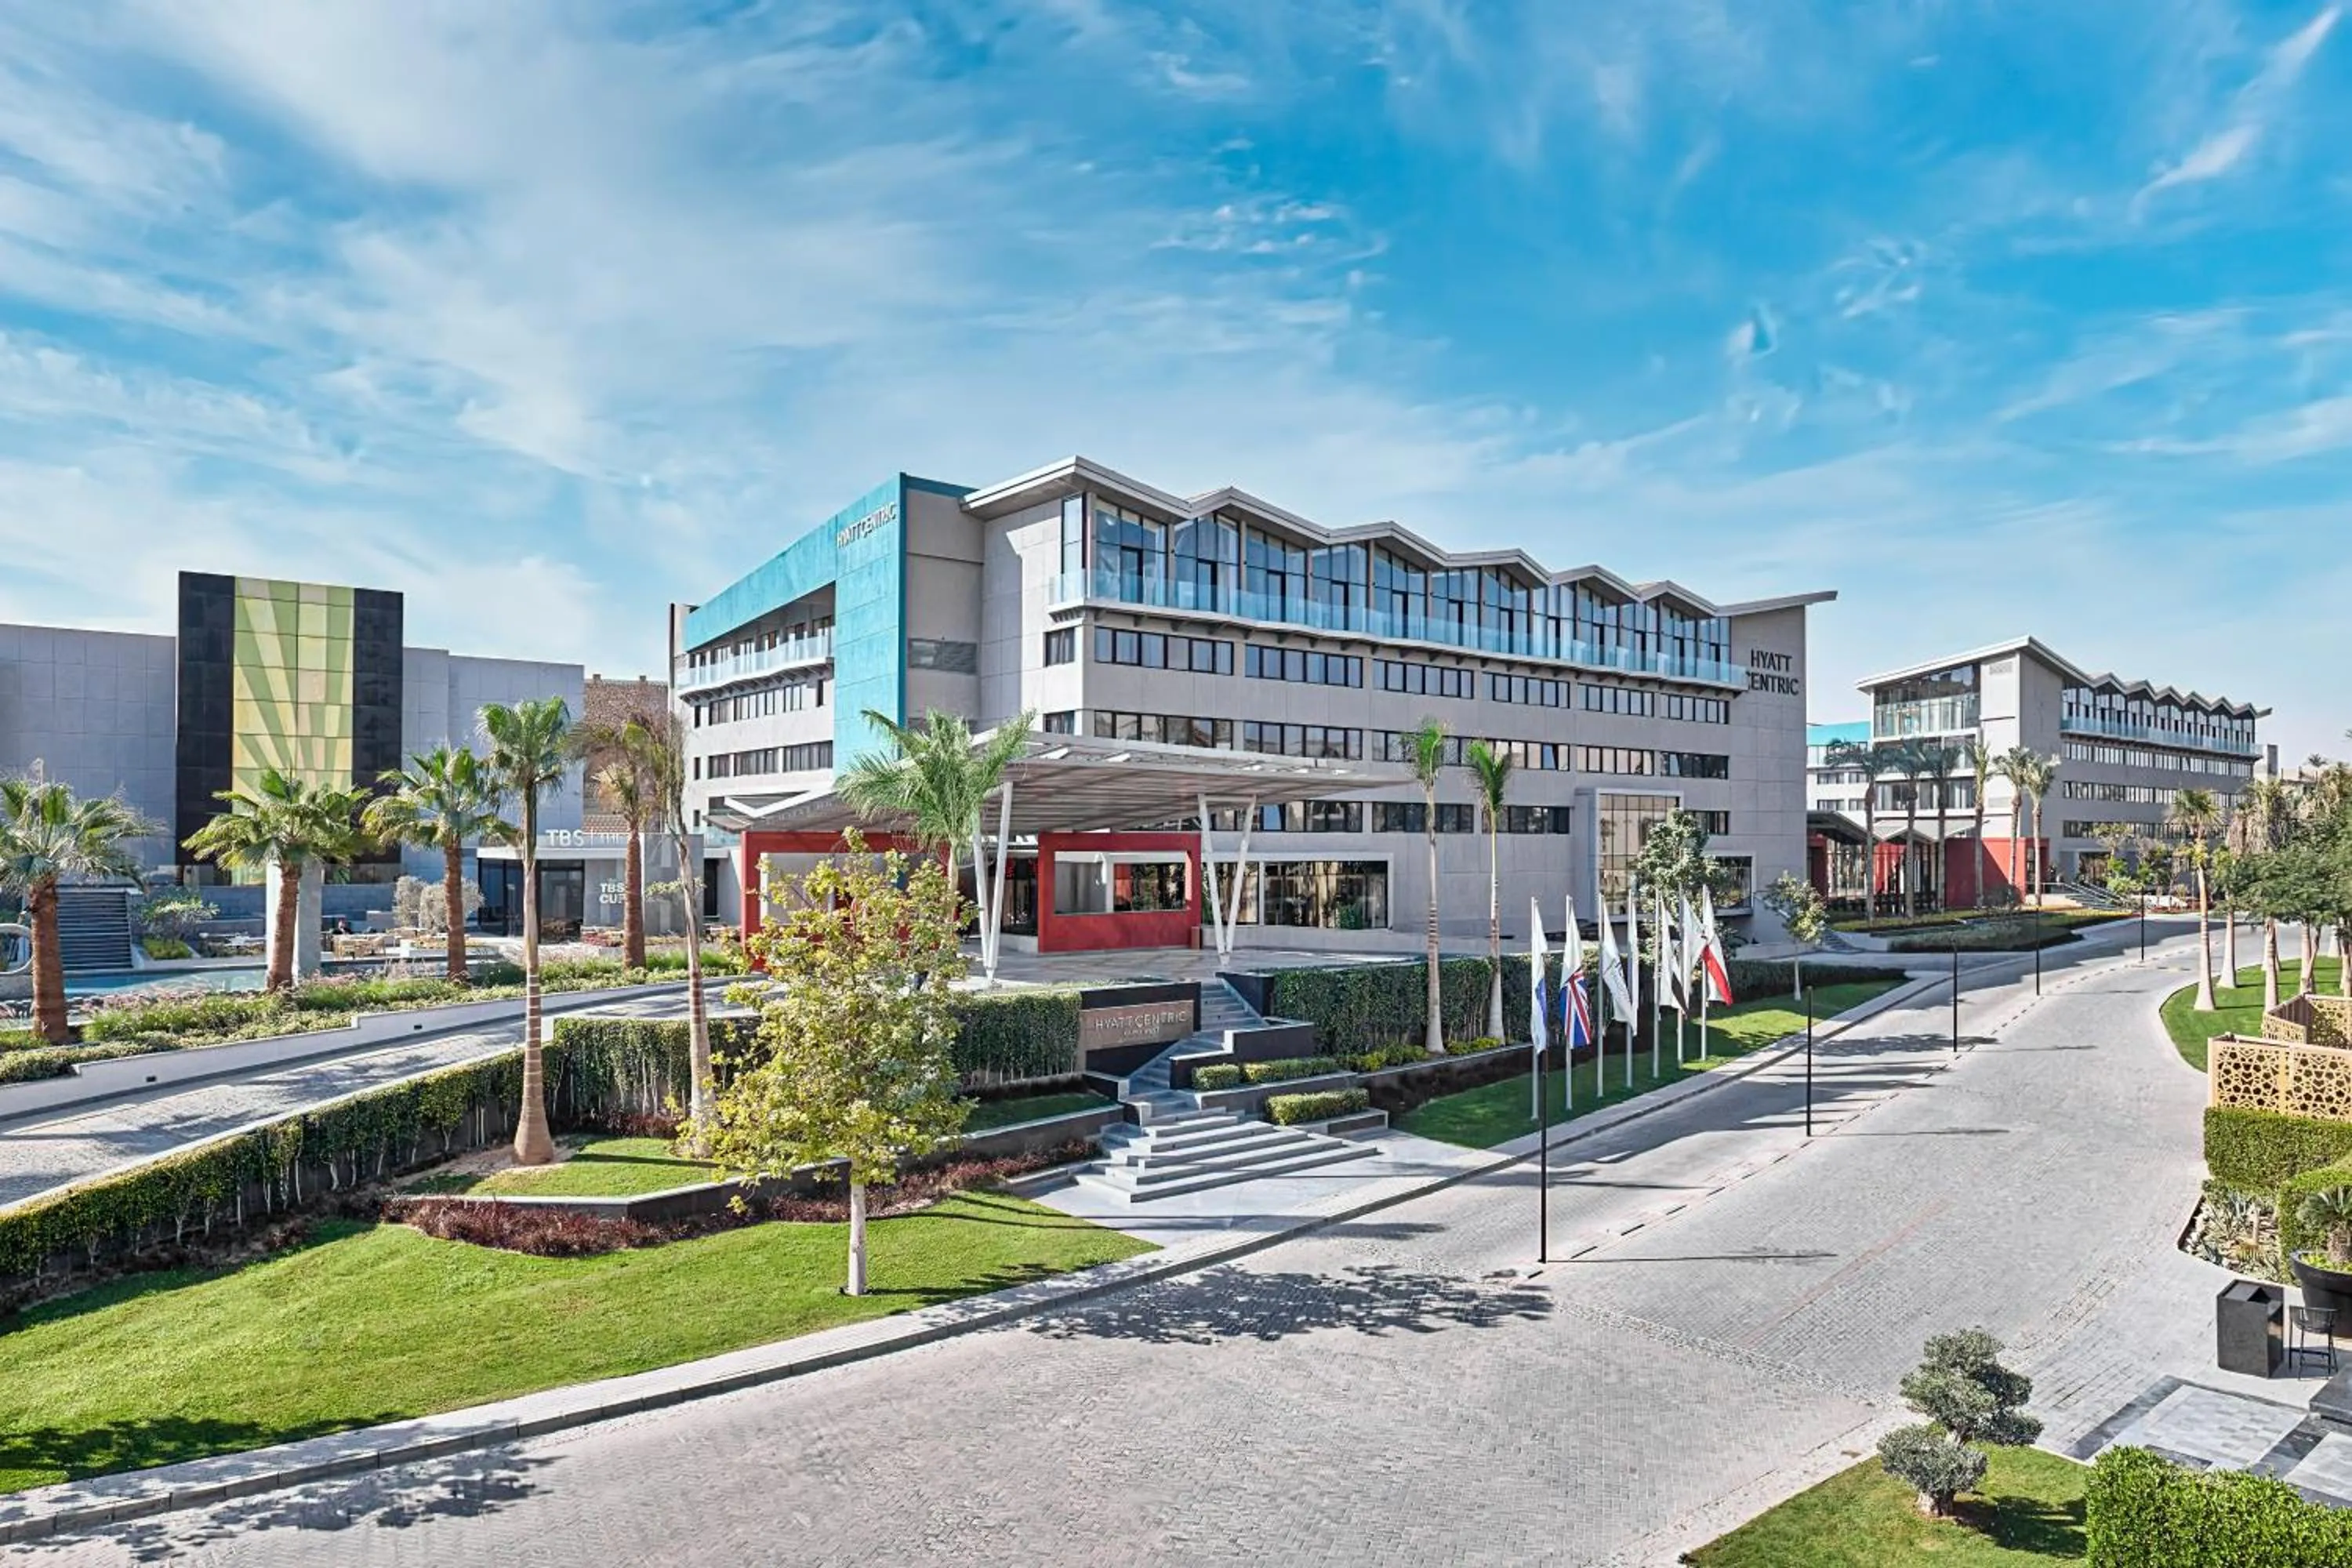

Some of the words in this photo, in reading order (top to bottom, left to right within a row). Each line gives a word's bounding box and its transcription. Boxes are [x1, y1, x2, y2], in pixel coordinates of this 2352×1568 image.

[1751, 648, 1793, 672] HYATT
[545, 829, 584, 847] TBS
[600, 882, 626, 893] TBS
